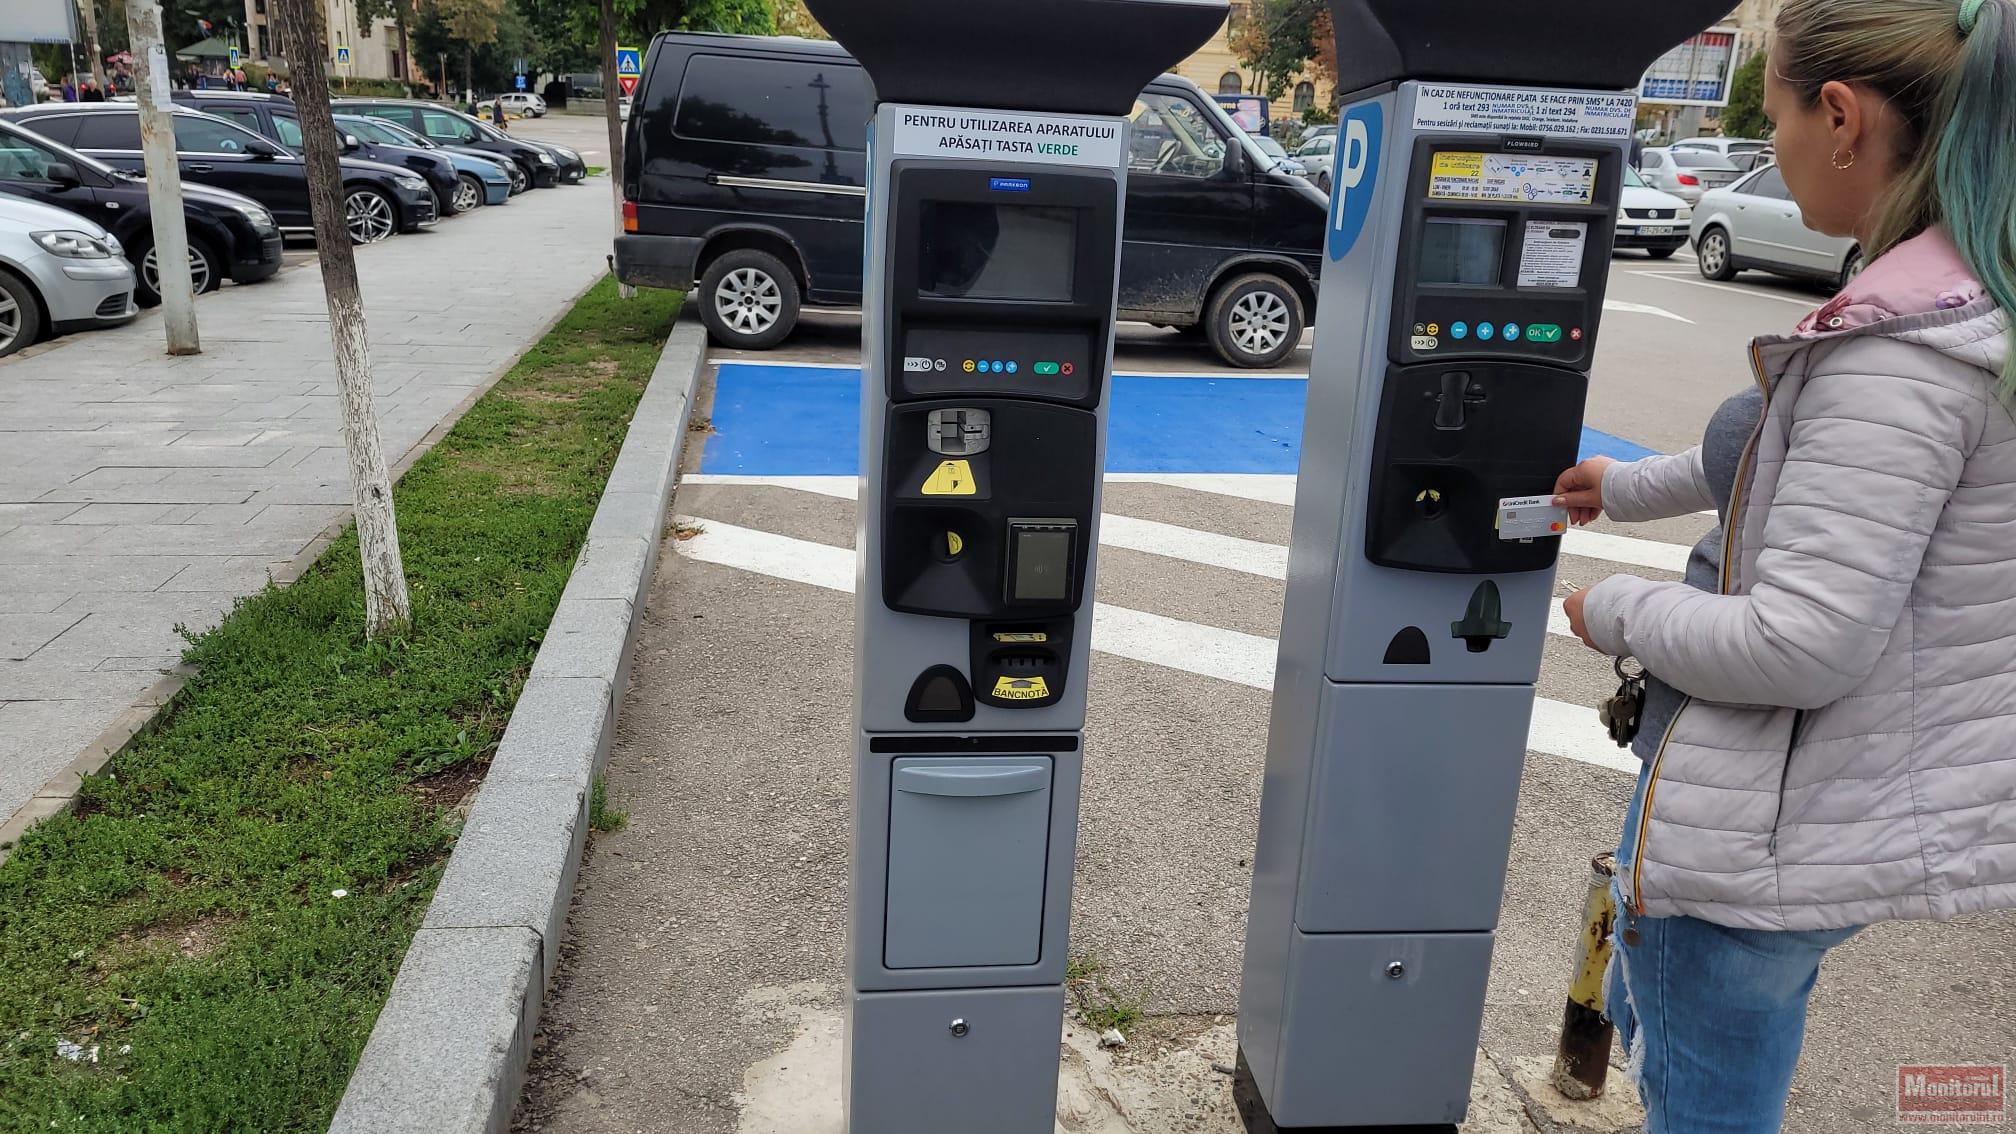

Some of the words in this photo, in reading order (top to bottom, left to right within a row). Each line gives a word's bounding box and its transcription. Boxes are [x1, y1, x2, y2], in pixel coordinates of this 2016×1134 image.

[1421, 86, 1429, 97] ÎN
[1431, 89, 1443, 98] CAZ
[1446, 90, 1455, 98] DE
[1457, 91, 1515, 102] NEFUNCȚIONARE
[1517, 94, 1537, 103] PLATA
[1540, 95, 1549, 103] SE
[1550, 96, 1566, 104] FACE
[1568, 96, 1585, 105] PRIN
[1606, 98, 1614, 106] LA
[1617, 99, 1632, 107] 7420
[1443, 102, 1447, 110] 1
[1449, 102, 1460, 110] oră
[1462, 103, 1475, 111] text
[1477, 104, 1490, 112] 293
[1541, 106, 1548, 115] zi
[1549, 107, 1562, 115] text
[1563, 108, 1576, 116] 294
[904, 114, 956, 129] PENTRU
[960, 118, 1033, 134] UTILIZAREA
[1036, 123, 1114, 139] APARATULUI
[1436, 119, 1457, 127] sesizări
[1458, 120, 1463, 129] și
[1464, 121, 1493, 131] reclamații
[1493, 123, 1511, 131] sunați
[1520, 123, 1538, 131] Mobil:
[1539, 124, 1576, 133] 0756.029.162
[1580, 126, 1590, 134] Fix:
[1591, 127, 1627, 135] 0231.518.671
[939, 135, 992, 153] APĂSAȚI
[996, 140, 1033, 153] TASTA
[1037, 143, 1078, 156] VERDE
[1336, 119, 1368, 230] P
[1529, 328, 1541, 336] OK
